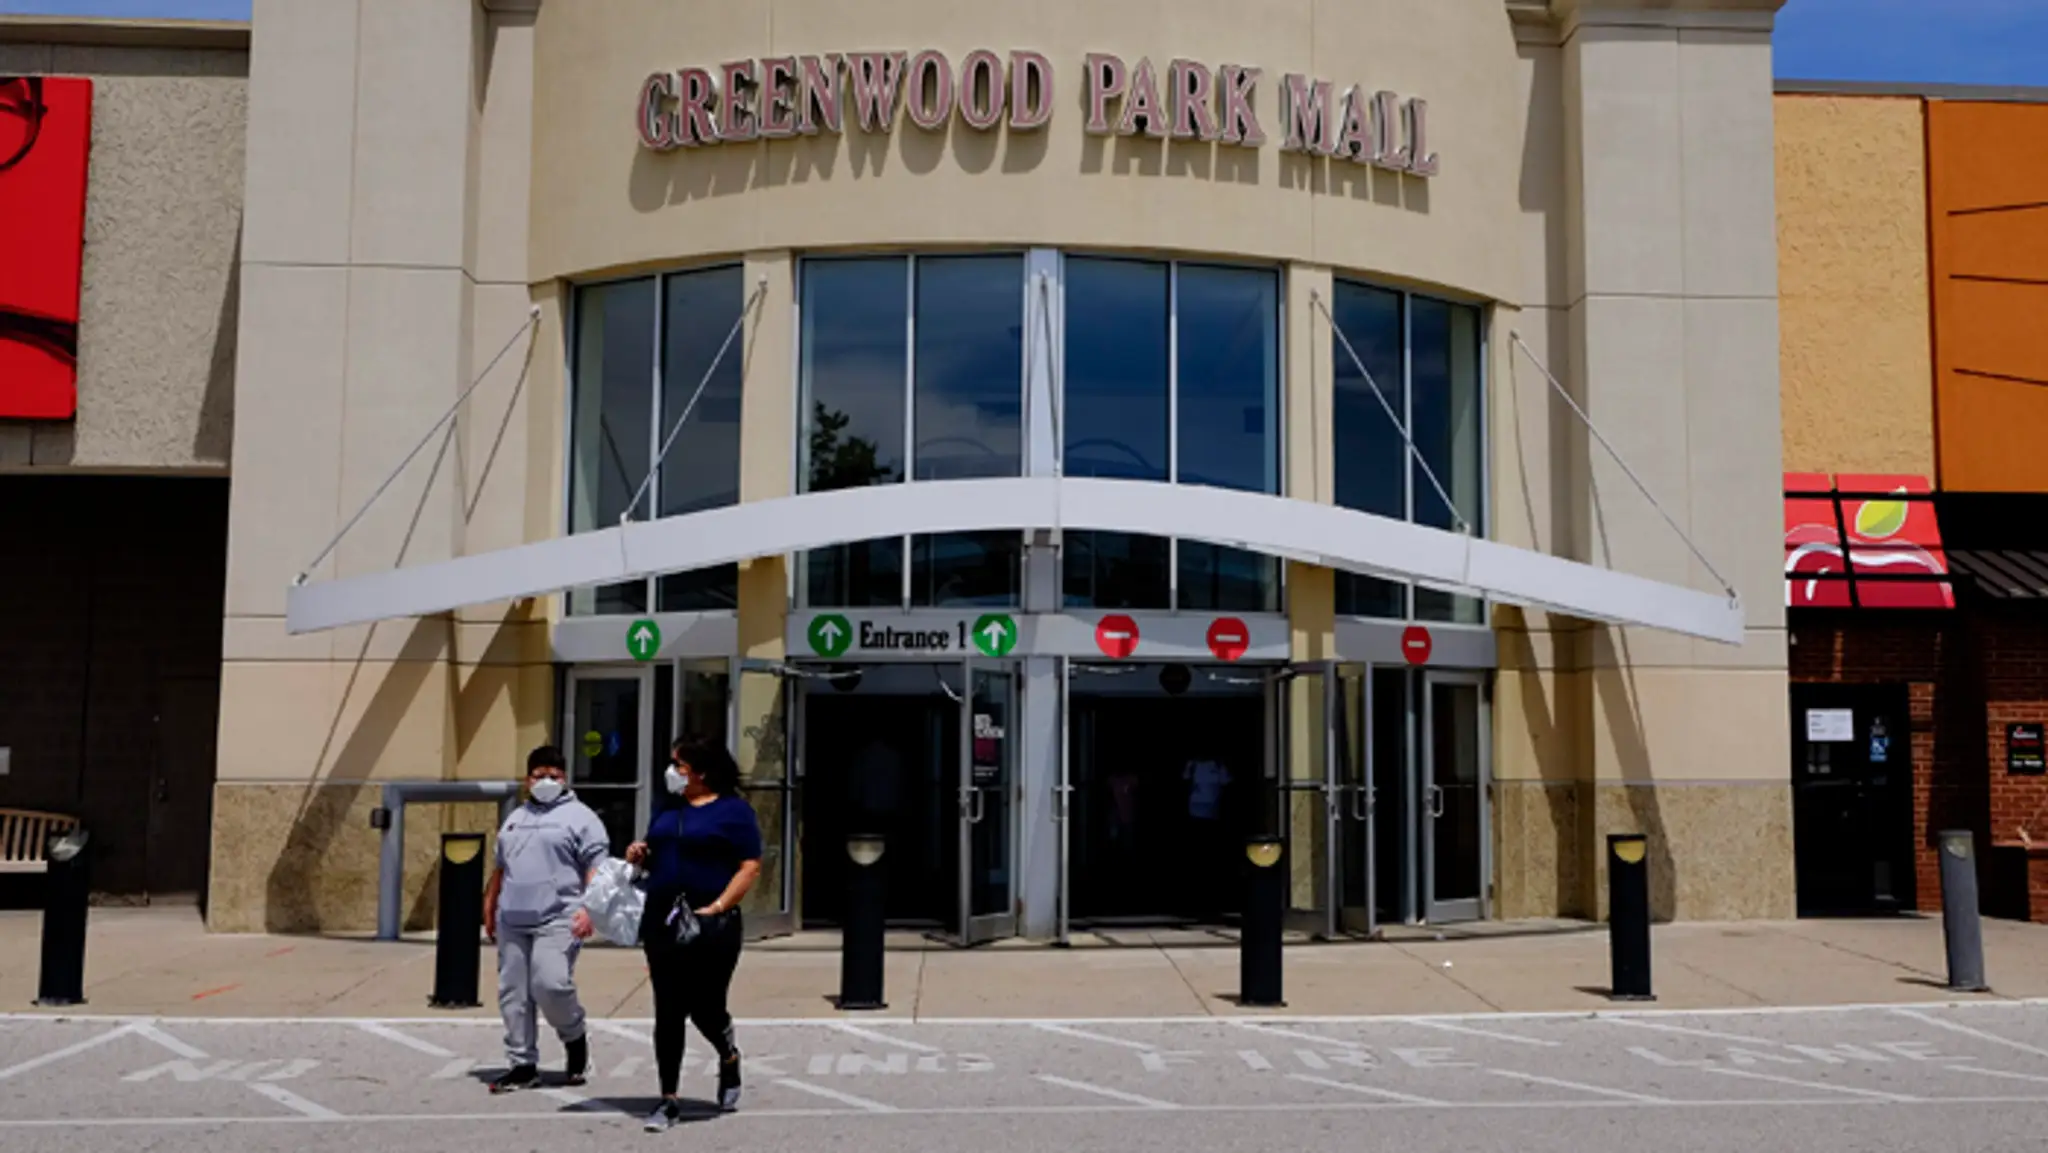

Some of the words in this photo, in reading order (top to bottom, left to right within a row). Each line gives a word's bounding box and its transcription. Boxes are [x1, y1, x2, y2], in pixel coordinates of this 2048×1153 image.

[636, 49, 1056, 151] GREENWOOD
[1080, 52, 1268, 147] PARK
[1278, 72, 1440, 177] MALL
[859, 620, 950, 651] Entrance
[957, 620, 967, 650] 1
[120, 1058, 322, 1082] NO
[1137, 1047, 1479, 1073] FIRE
[1624, 1042, 1978, 1067] LANE
